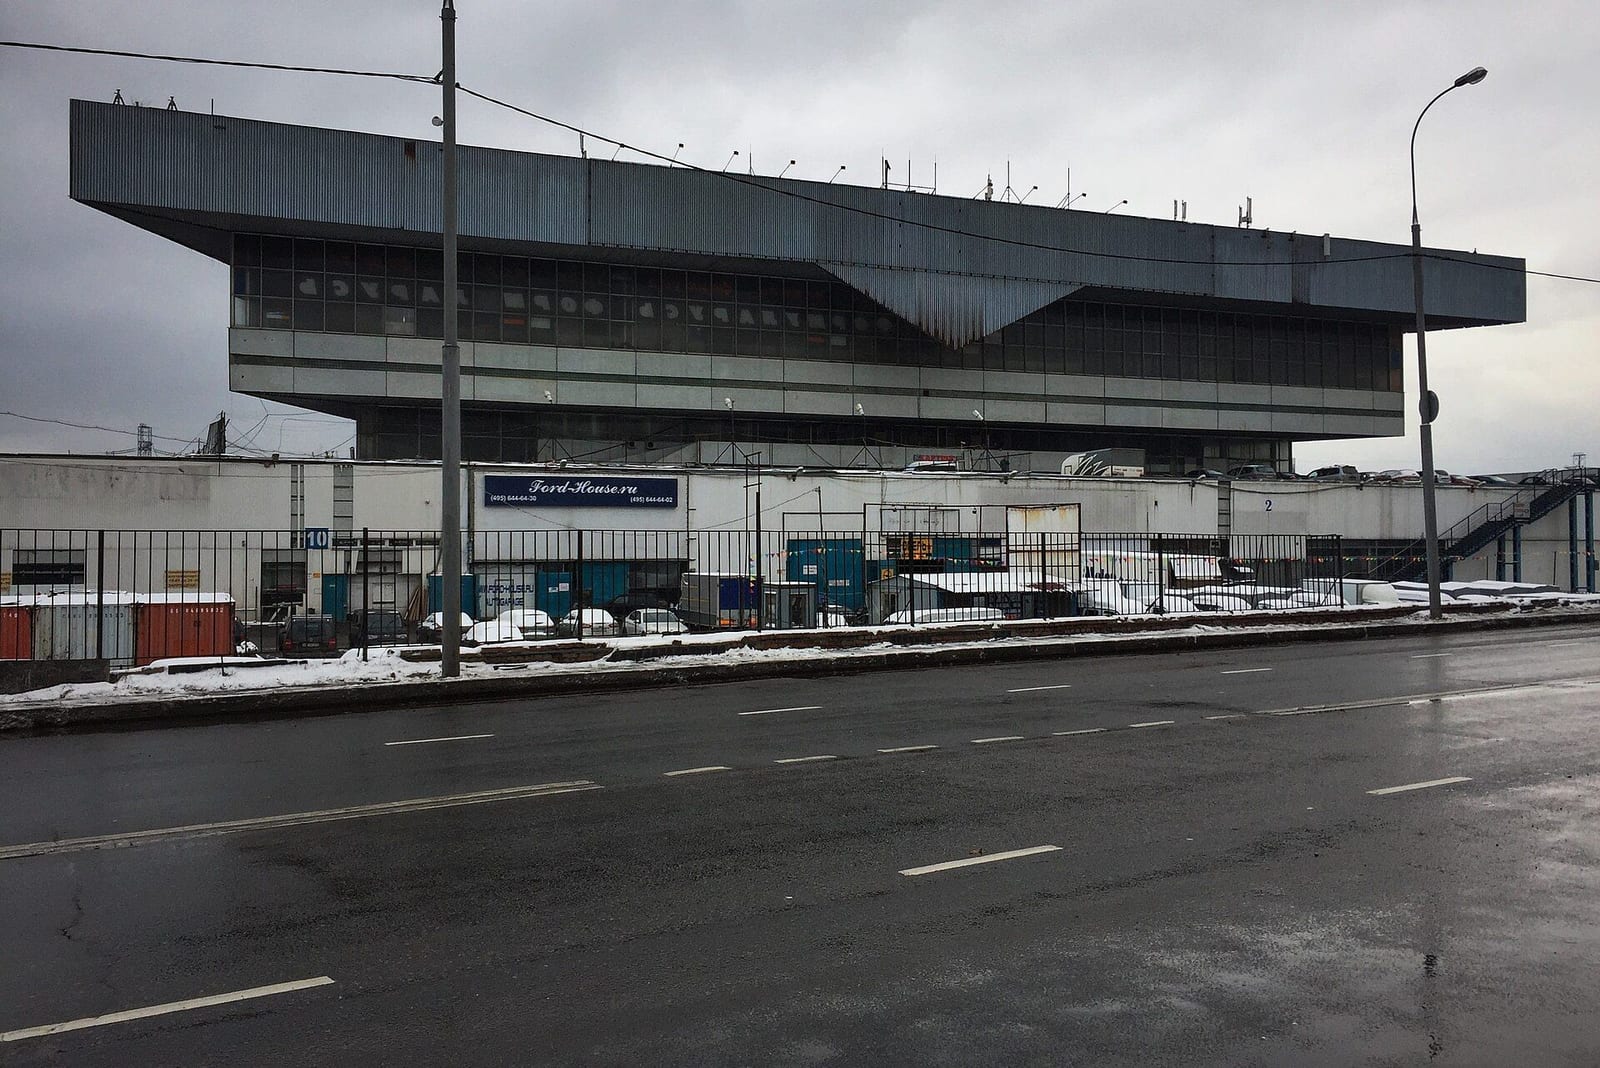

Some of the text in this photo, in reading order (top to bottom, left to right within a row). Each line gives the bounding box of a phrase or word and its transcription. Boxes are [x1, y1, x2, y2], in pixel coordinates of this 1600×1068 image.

[528, 479, 638, 494] Ford-House.ru
[490, 494, 506, 502] (495)
[1265, 499, 1272, 512] 2
[307, 531, 327, 546] 10
